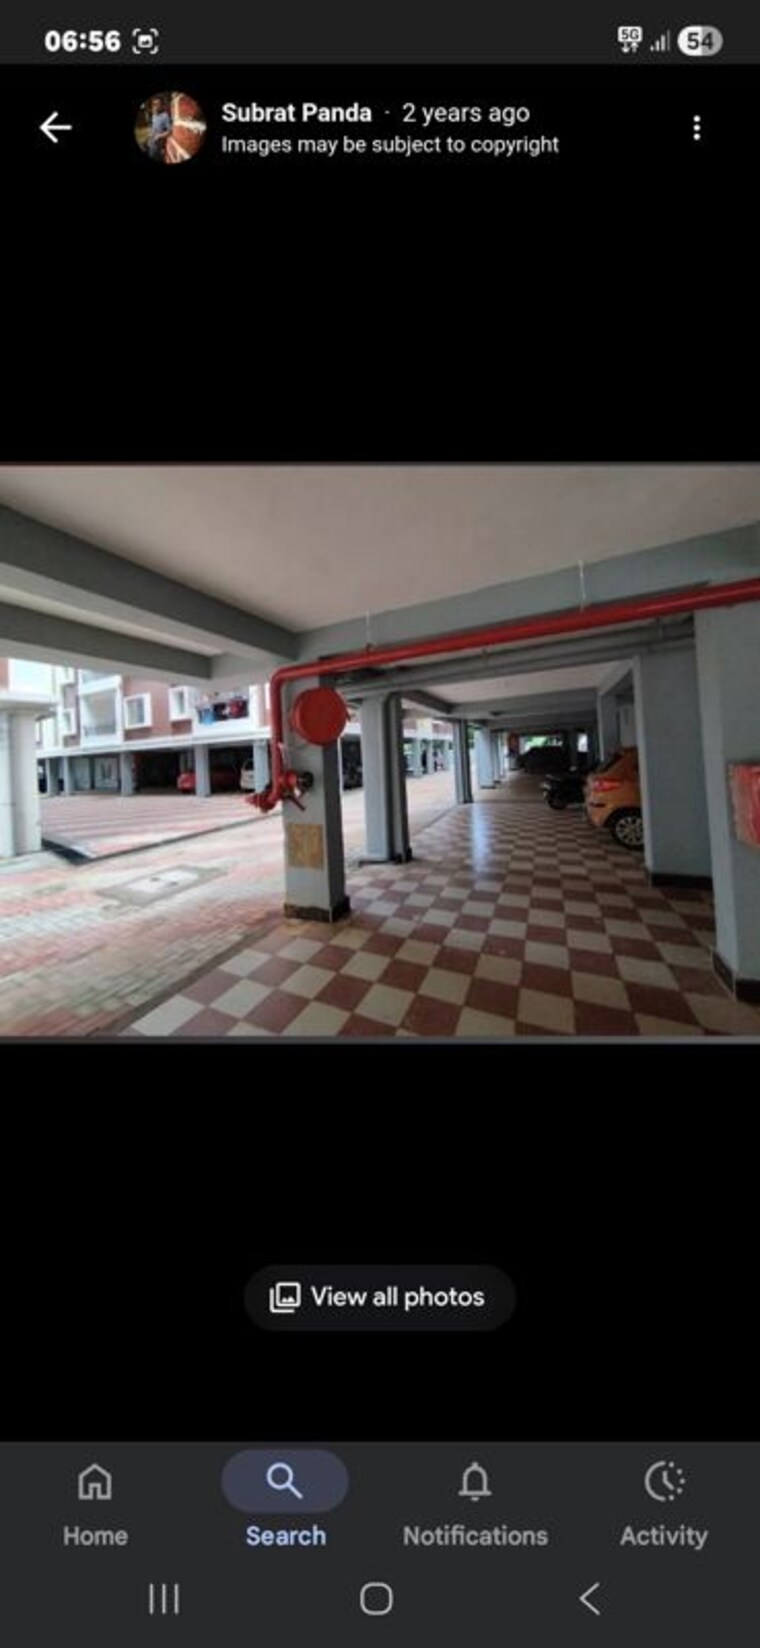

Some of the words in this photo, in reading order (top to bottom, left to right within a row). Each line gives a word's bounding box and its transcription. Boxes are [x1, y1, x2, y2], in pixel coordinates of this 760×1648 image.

[44, 29, 121, 53] 06:56
[687, 32, 713, 51] 54
[221, 102, 296, 123] Subrat
[302, 102, 372, 123] Panda
[402, 102, 416, 123] 2
[421, 106, 482, 127] years
[488, 106, 531, 127] ago
[222, 136, 292, 157] Images
[297, 140, 339, 157] may
[343, 136, 367, 153] be
[372, 136, 441, 157] subject
[446, 136, 466, 153] to
[470, 136, 559, 157] copyright
[310, 1286, 368, 1307] View
[372, 1286, 398, 1307] all
[404, 1286, 485, 1312] photos
[63, 1526, 128, 1546] Home
[246, 1525, 326, 1546] Search
[403, 1525, 548, 1546] Notifications
[620, 1525, 708, 1551] Activity
